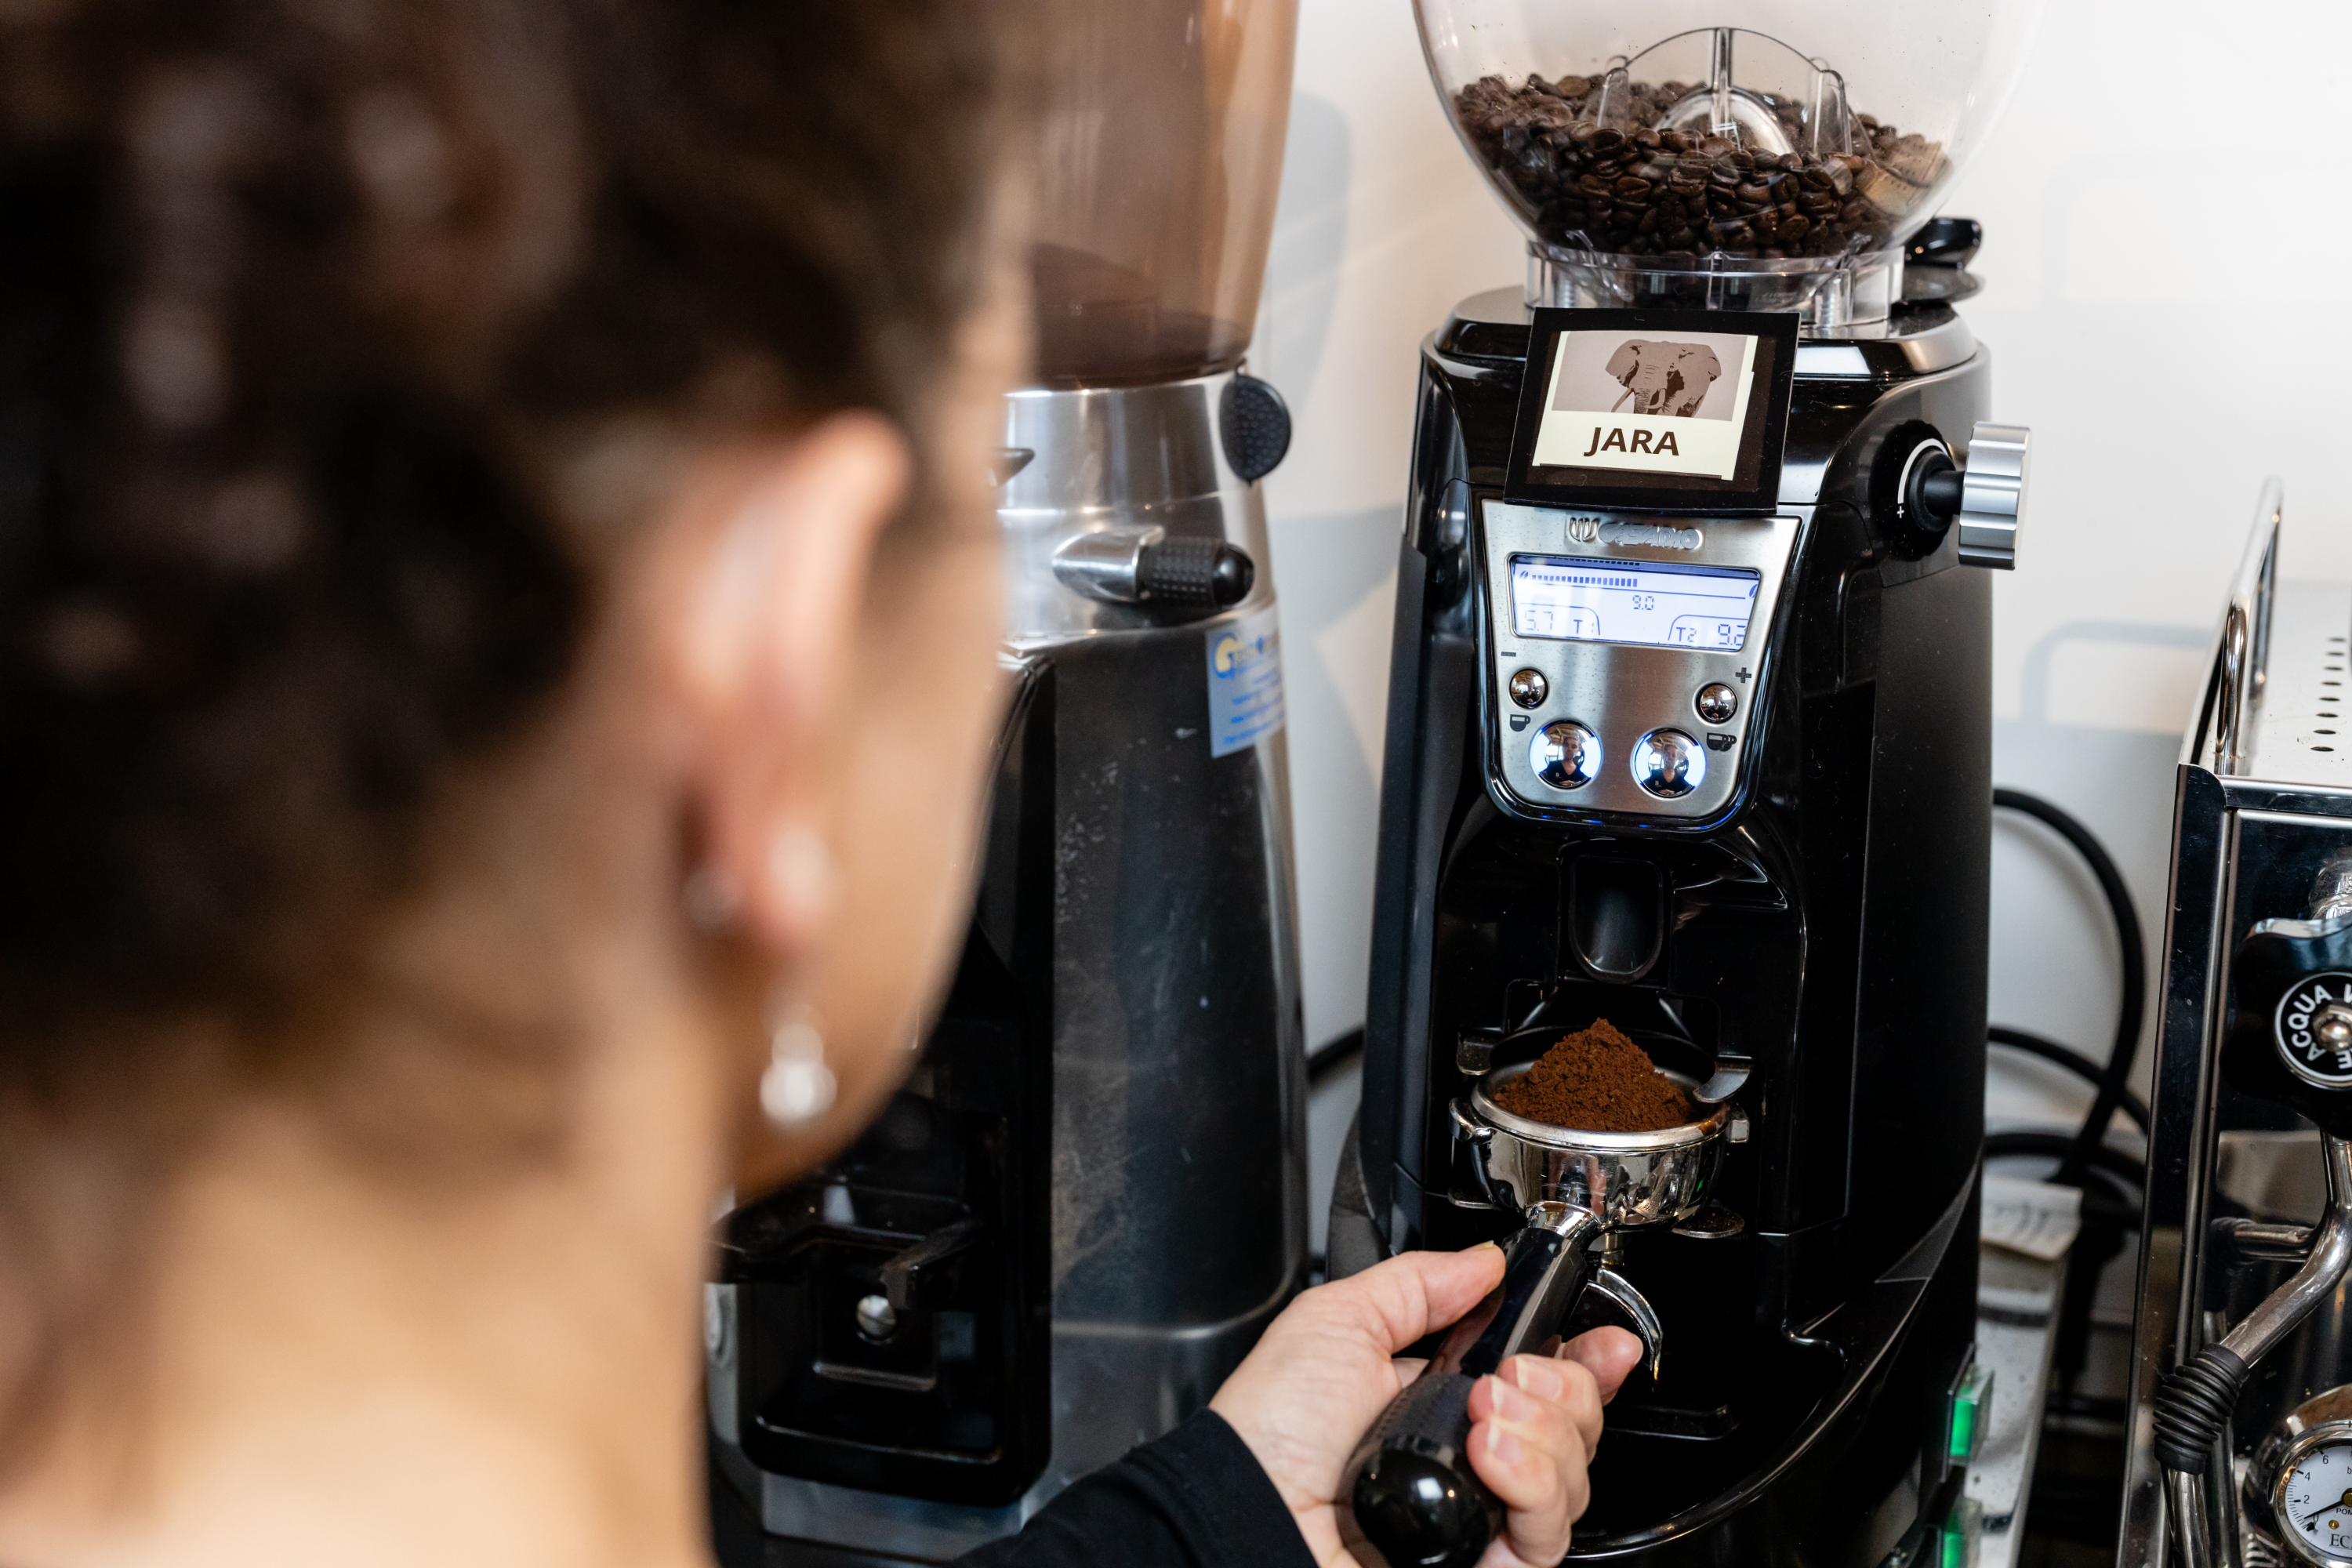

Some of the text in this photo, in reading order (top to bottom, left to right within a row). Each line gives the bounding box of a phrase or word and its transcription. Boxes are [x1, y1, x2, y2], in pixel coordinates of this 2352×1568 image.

[1583, 426, 1679, 457] JARA
[1632, 594, 1654, 611] 9.0
[1524, 610, 1554, 631] 5.7
[2288, 985, 2333, 1061] ACQUA
[2322, 1455, 2329, 1465] 6
[2304, 1472, 2311, 1481] 4
[2303, 1495, 2310, 1504] 2
